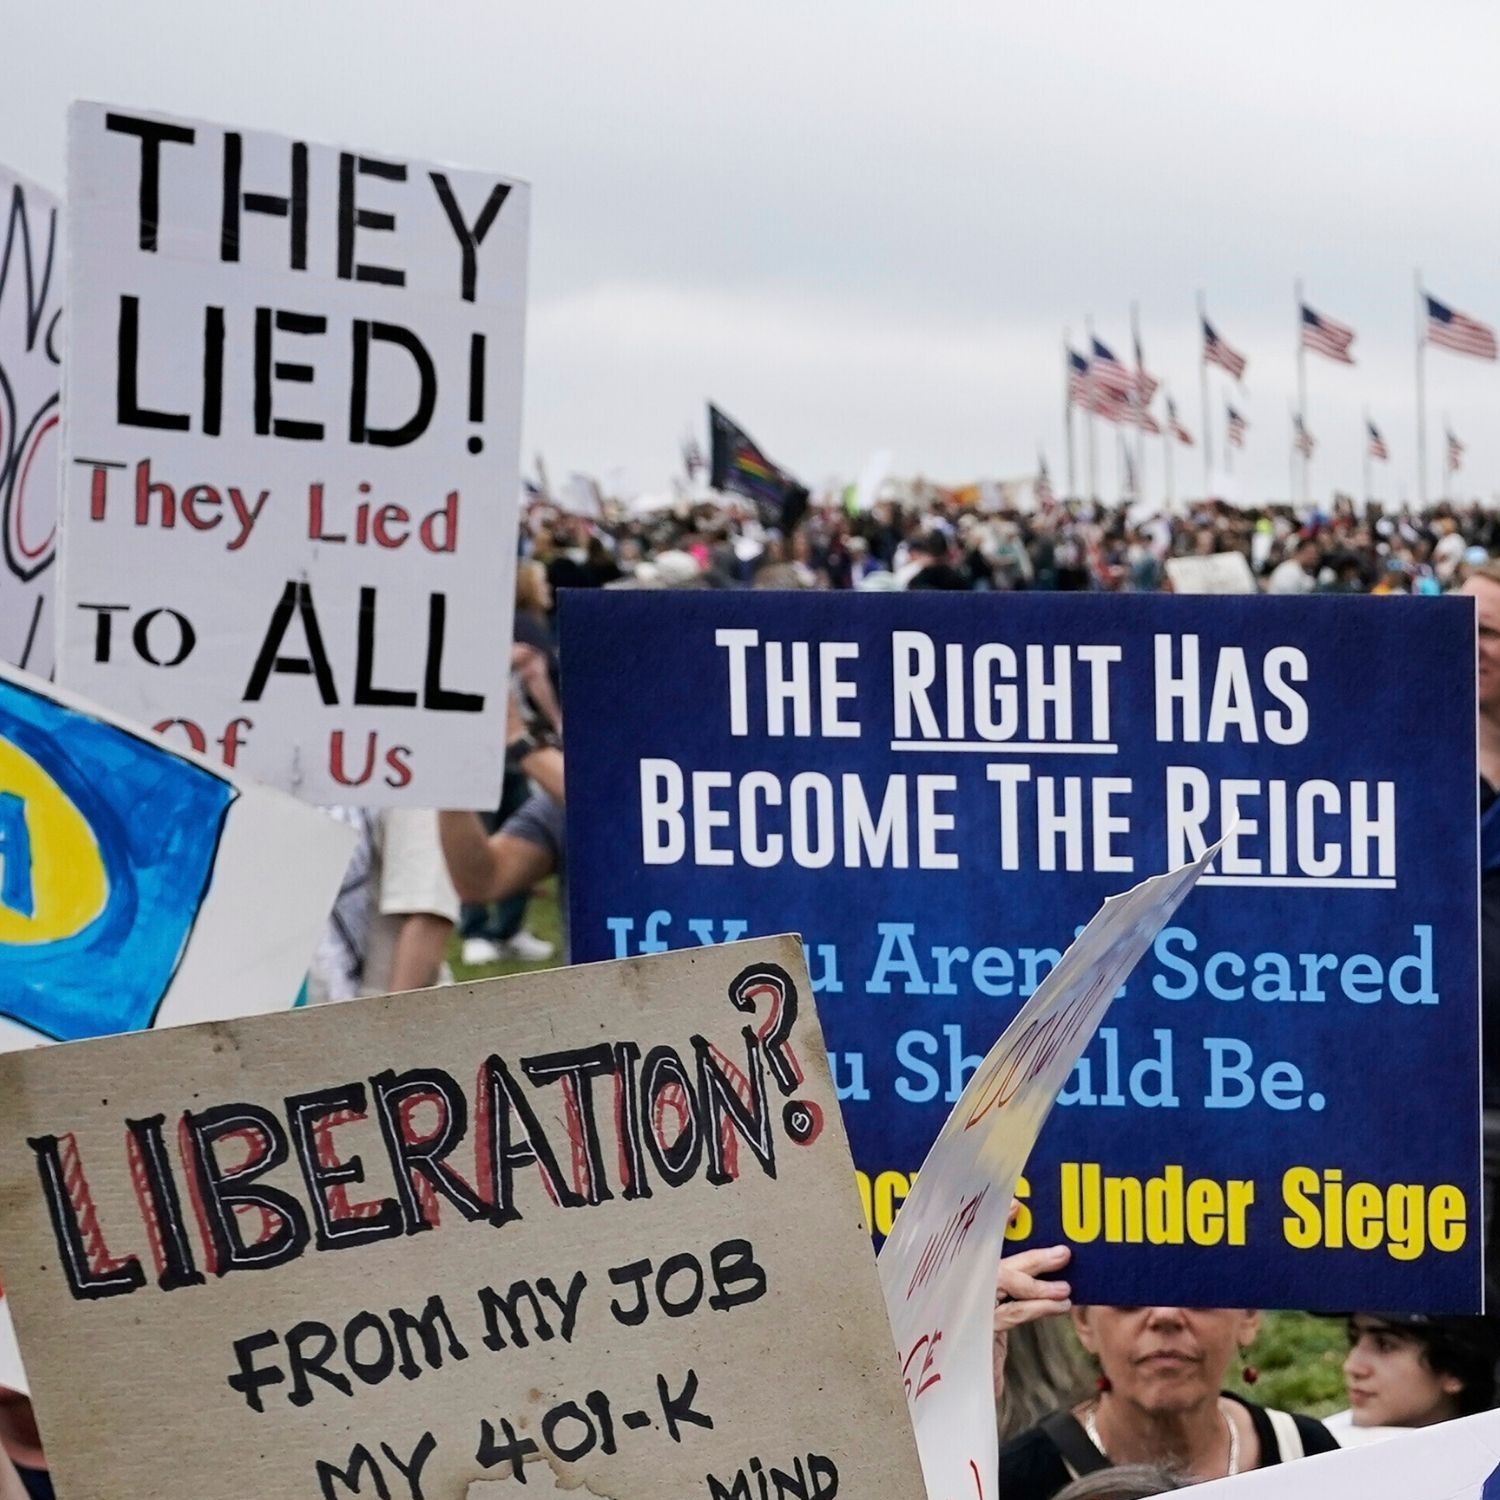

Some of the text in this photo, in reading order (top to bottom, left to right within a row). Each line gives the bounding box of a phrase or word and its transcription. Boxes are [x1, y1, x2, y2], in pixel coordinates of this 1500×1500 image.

[106, 111, 512, 303] THEY
[117, 295, 486, 455] LIED!
[74, 458, 459, 554] They Lied
[77, 603, 196, 667] TO
[242, 581, 486, 712] ALL
[715, 629, 1310, 746] THE RIGHT HAS
[329, 730, 413, 788] Us
[640, 758, 1397, 878] BECOME THE REICH
[1151, 924, 1440, 1005] Scared
[894, 1024, 1180, 1110] Shuld
[1203, 1037, 1326, 1111] Be.
[27, 962, 824, 1300] LIBERATION?
[1060, 1162, 1255, 1247] Under
[1282, 1165, 1468, 1261] Siege
[228, 1238, 767, 1413] FROM MY JOB
[475, 1368, 714, 1485] 401-K
